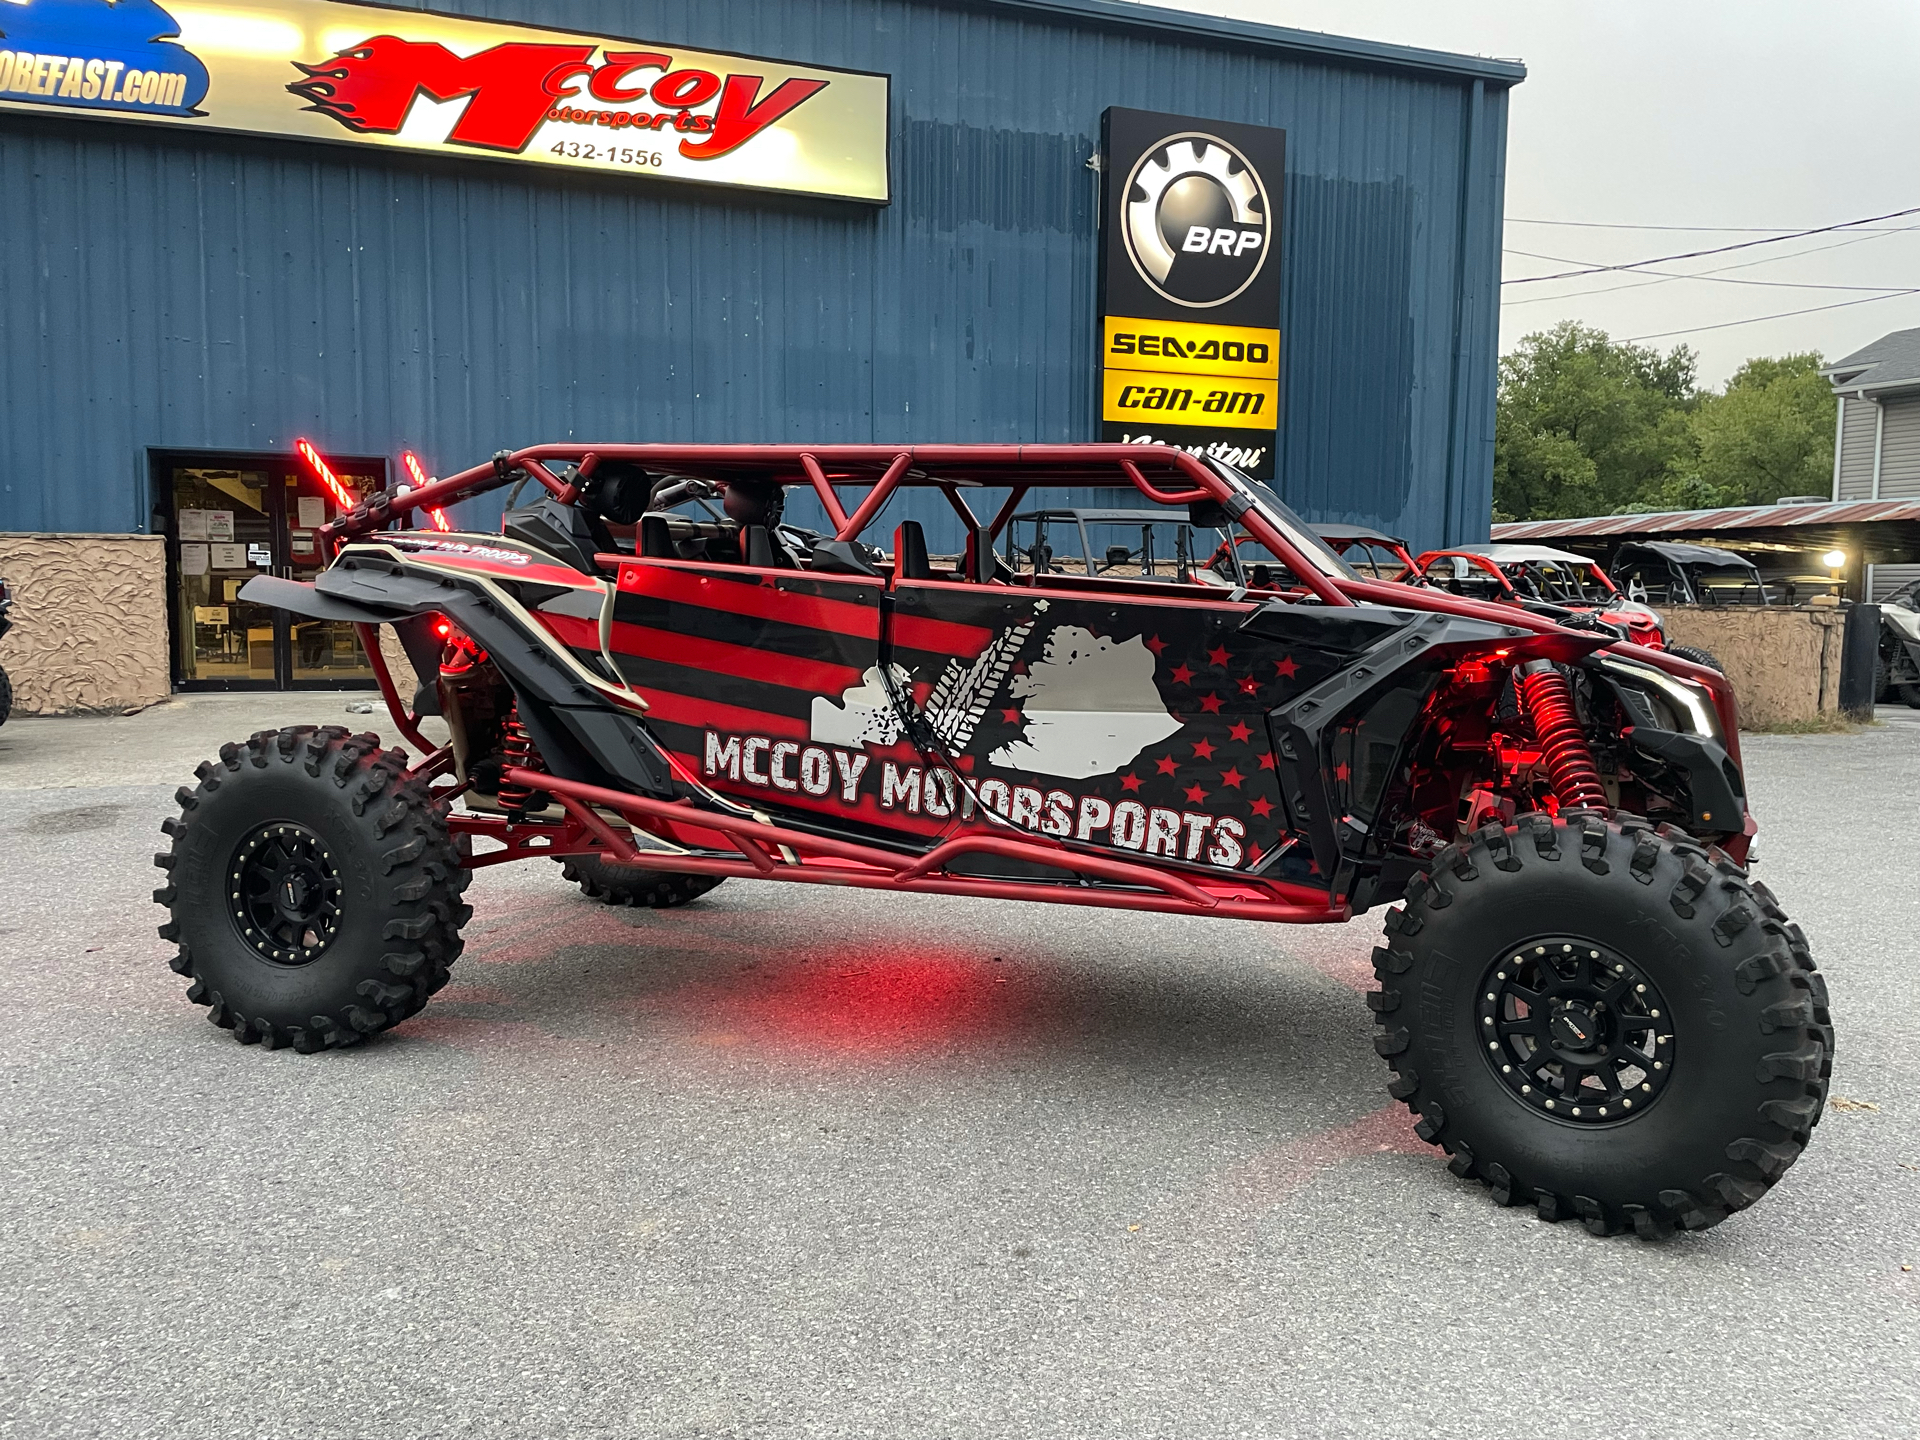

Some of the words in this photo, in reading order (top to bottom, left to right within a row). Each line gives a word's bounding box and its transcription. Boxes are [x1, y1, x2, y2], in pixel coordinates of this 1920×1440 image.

[550, 140, 663, 168] 432-1556
[1181, 224, 1263, 258] BRP
[469, 546, 531, 565] TROOPS
[703, 729, 871, 803] MCCOY
[881, 761, 1247, 868] MOTORSPORTS
